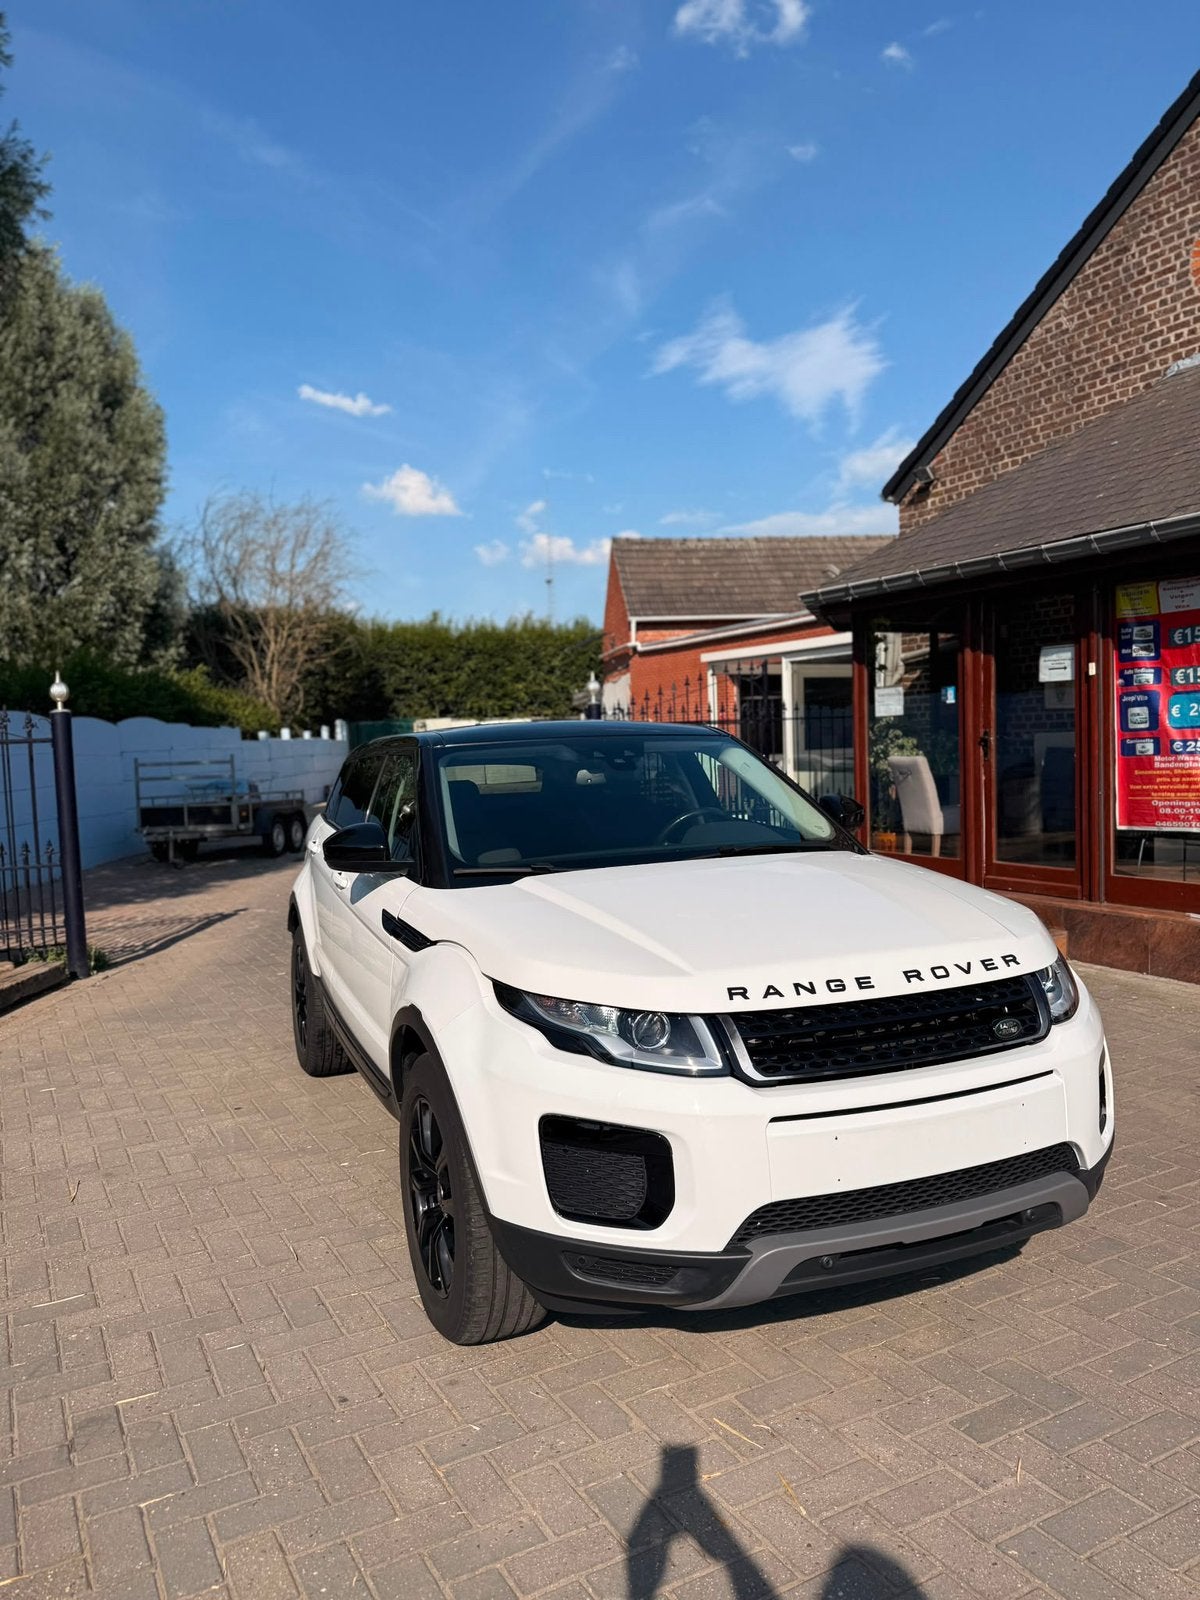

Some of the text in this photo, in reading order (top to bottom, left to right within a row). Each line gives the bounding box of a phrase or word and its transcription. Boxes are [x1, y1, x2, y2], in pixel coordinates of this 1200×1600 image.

[1174, 626, 1200, 644] €15
[1189, 703, 1200, 716] 2
[726, 954, 1022, 1001] RANGE ROVER
